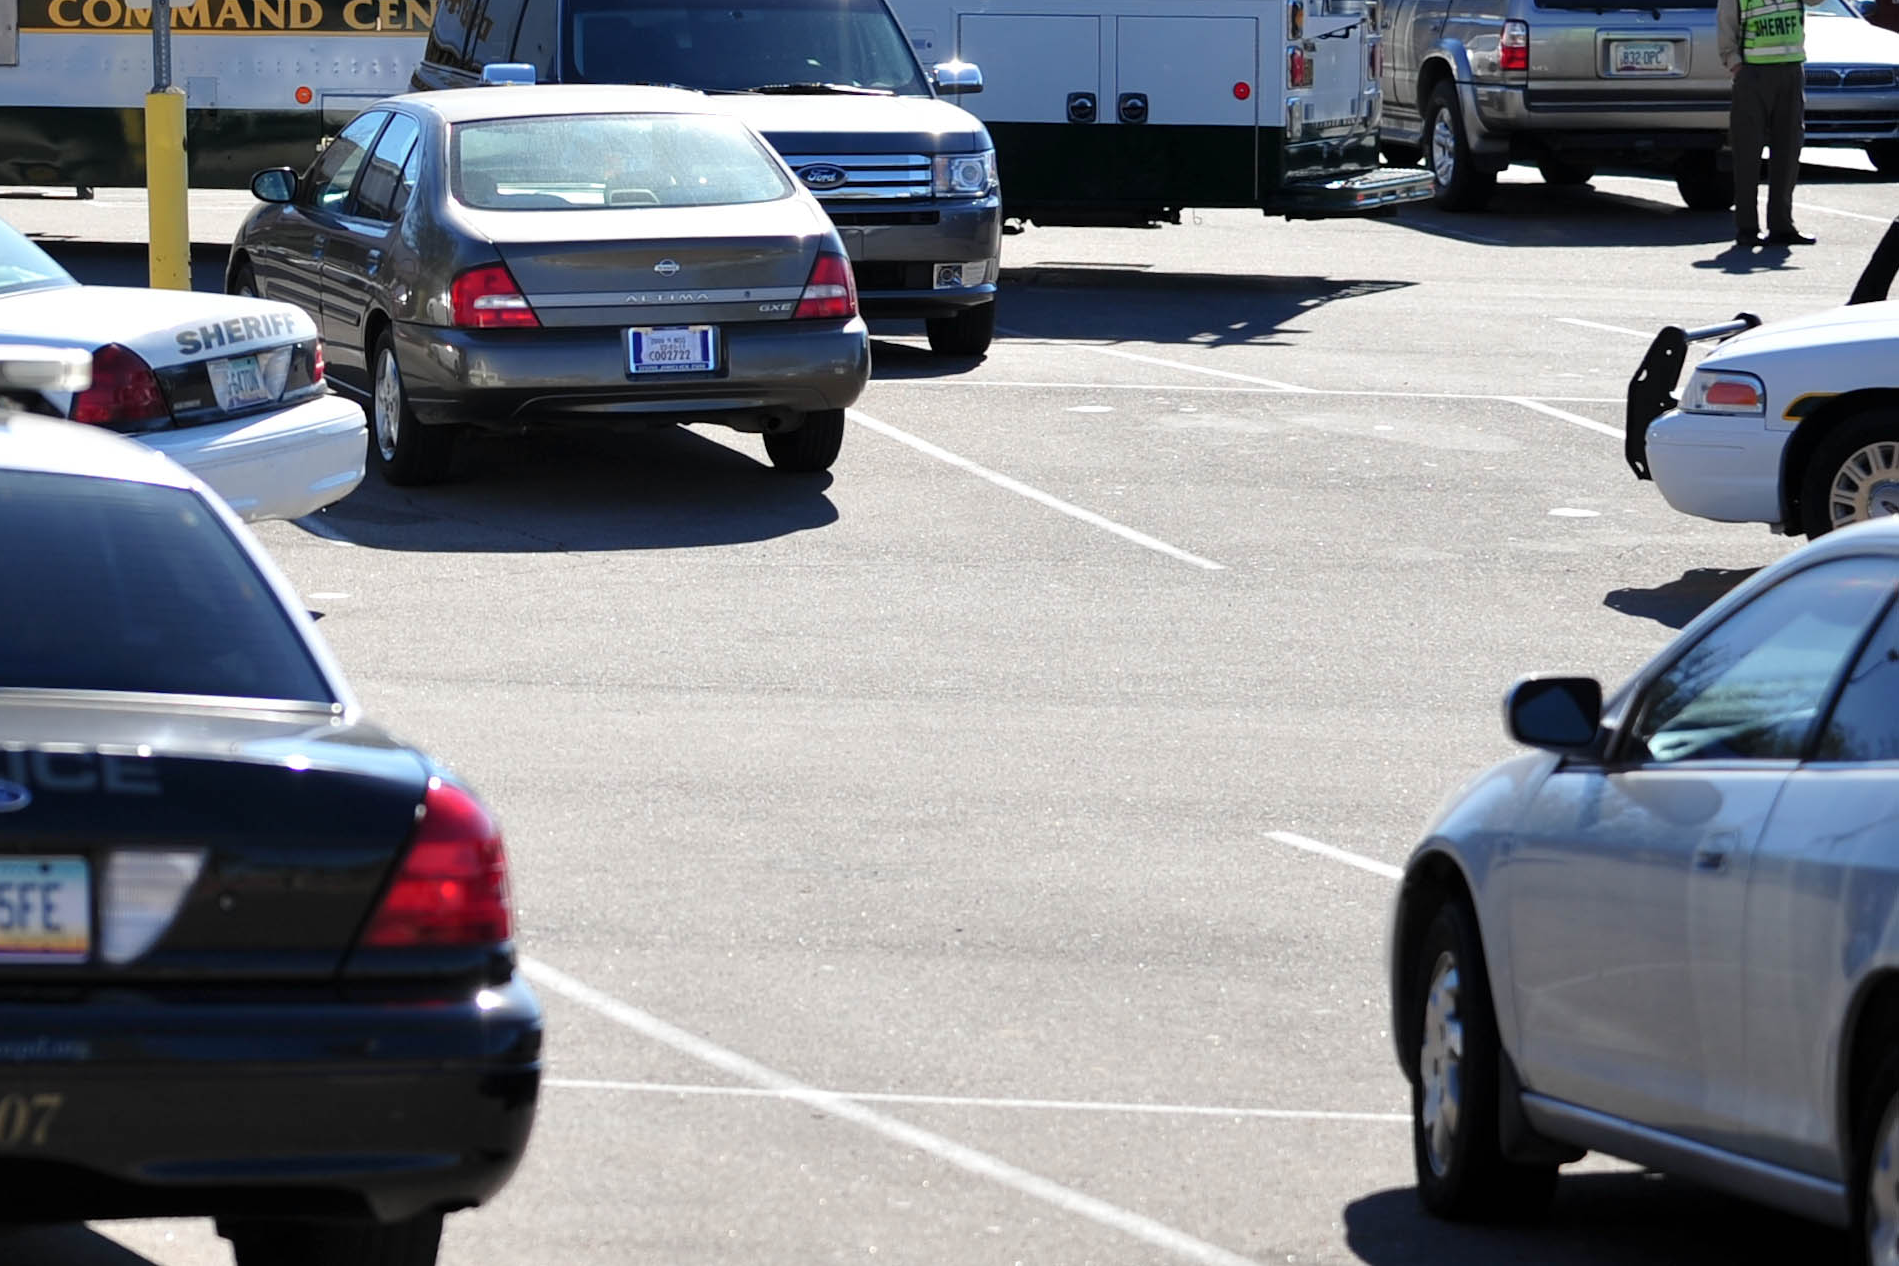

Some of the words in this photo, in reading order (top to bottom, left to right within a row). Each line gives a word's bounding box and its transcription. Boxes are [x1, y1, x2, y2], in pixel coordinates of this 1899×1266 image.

[1755, 15, 1797, 37] SHERIFF
[807, 168, 837, 183] Ford
[626, 293, 710, 303] ALTIMA
[758, 302, 793, 313] GXE
[175, 312, 297, 356] SHERIFF
